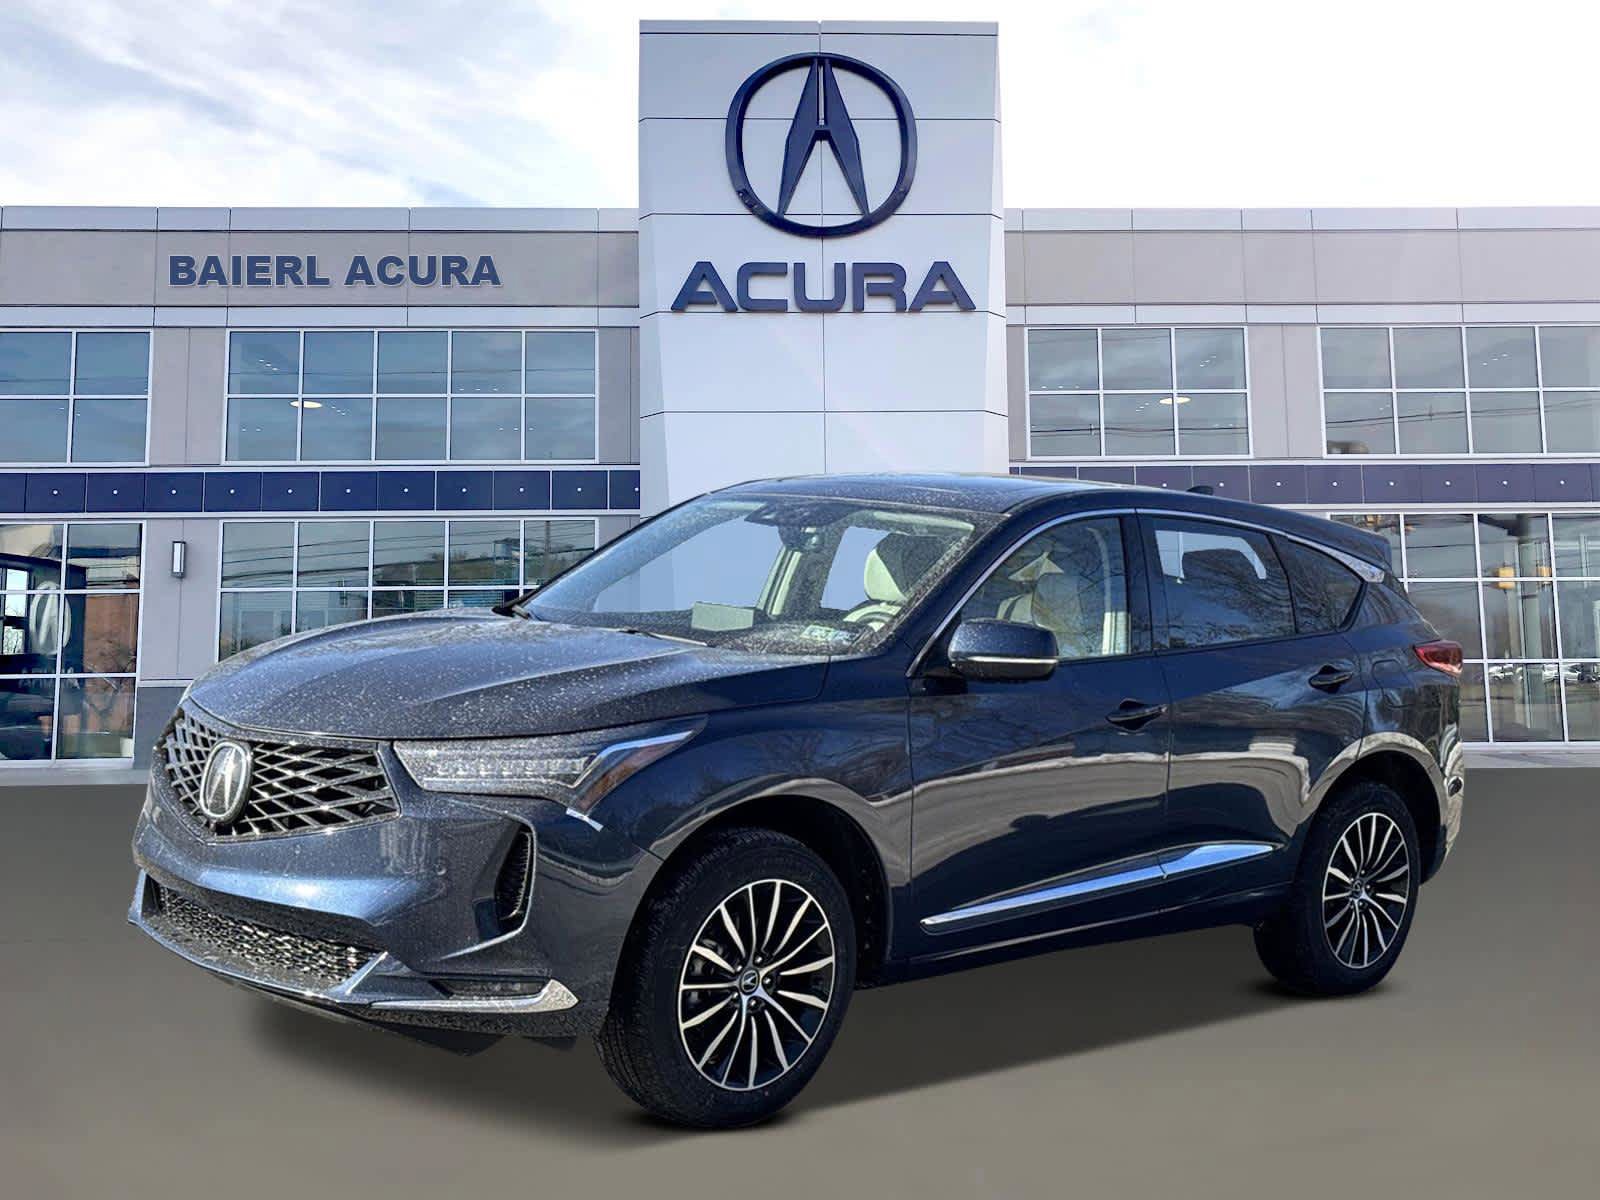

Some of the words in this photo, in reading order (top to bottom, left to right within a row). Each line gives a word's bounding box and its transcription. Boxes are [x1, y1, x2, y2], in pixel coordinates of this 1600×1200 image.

[169, 255, 331, 286] BAIERL
[344, 255, 502, 286] ACURA
[670, 260, 977, 313] ACURA
